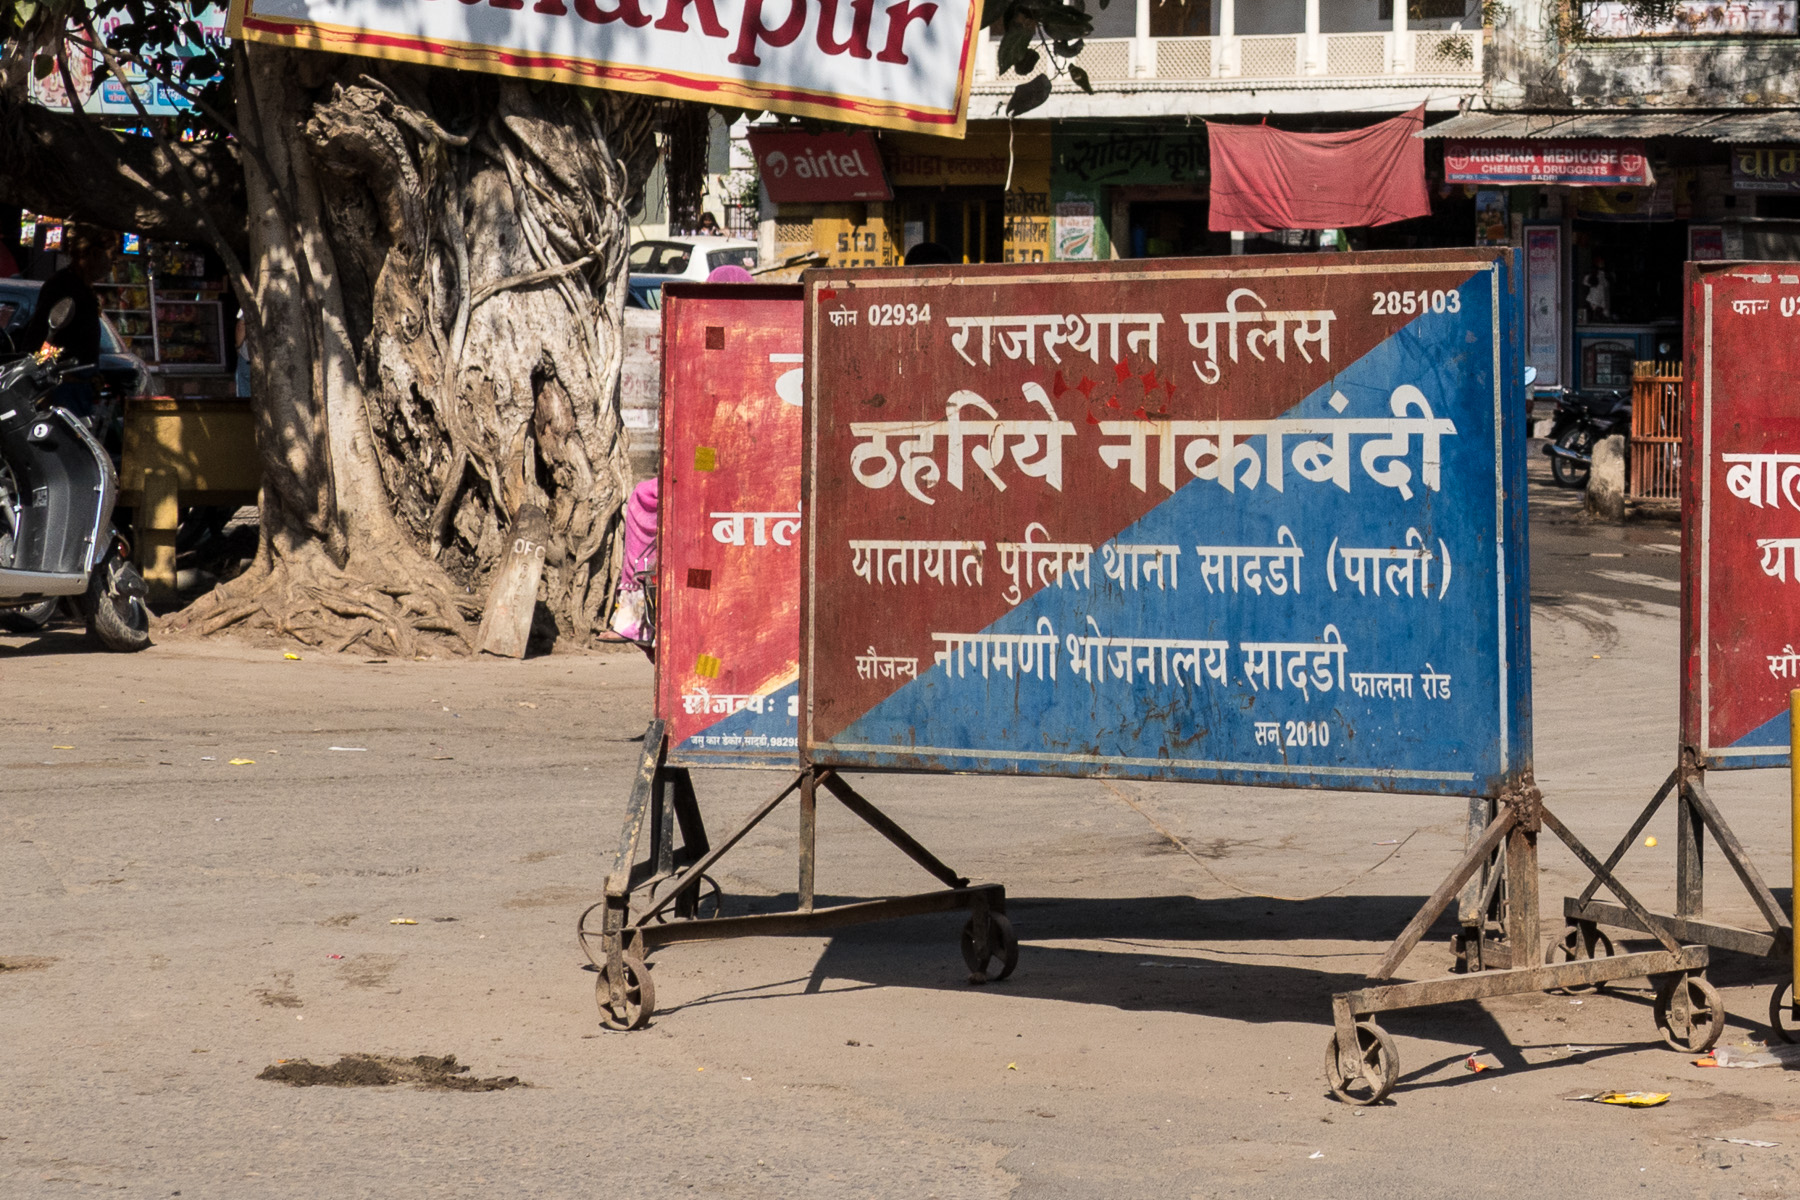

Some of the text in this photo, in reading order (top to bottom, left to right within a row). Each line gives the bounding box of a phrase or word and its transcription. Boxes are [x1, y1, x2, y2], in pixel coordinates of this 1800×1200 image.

[793, 147, 870, 179] airtel
[1470, 147, 1618, 164] KRISHNA MEDICOSE
[1482, 165, 1608, 175] CHEMIST & DRUGGISTS
[838, 232, 878, 252] S.T.D.
[829, 287, 1460, 383] फोन 02934 राजस्थान पुलिस 285103
[849, 382, 1458, 504] ठहरिये नाकाबंदी
[513, 538, 546, 560] OFC
[849, 522, 1453, 604] यातायात पुलिस थाना सादडी (पाली)
[855, 615, 1452, 702] सौजन्य नागमणी भोजनालय सादडी फालना रोड
[706, 735, 720, 746] कार
[1286, 721, 1330, 747] 2010
